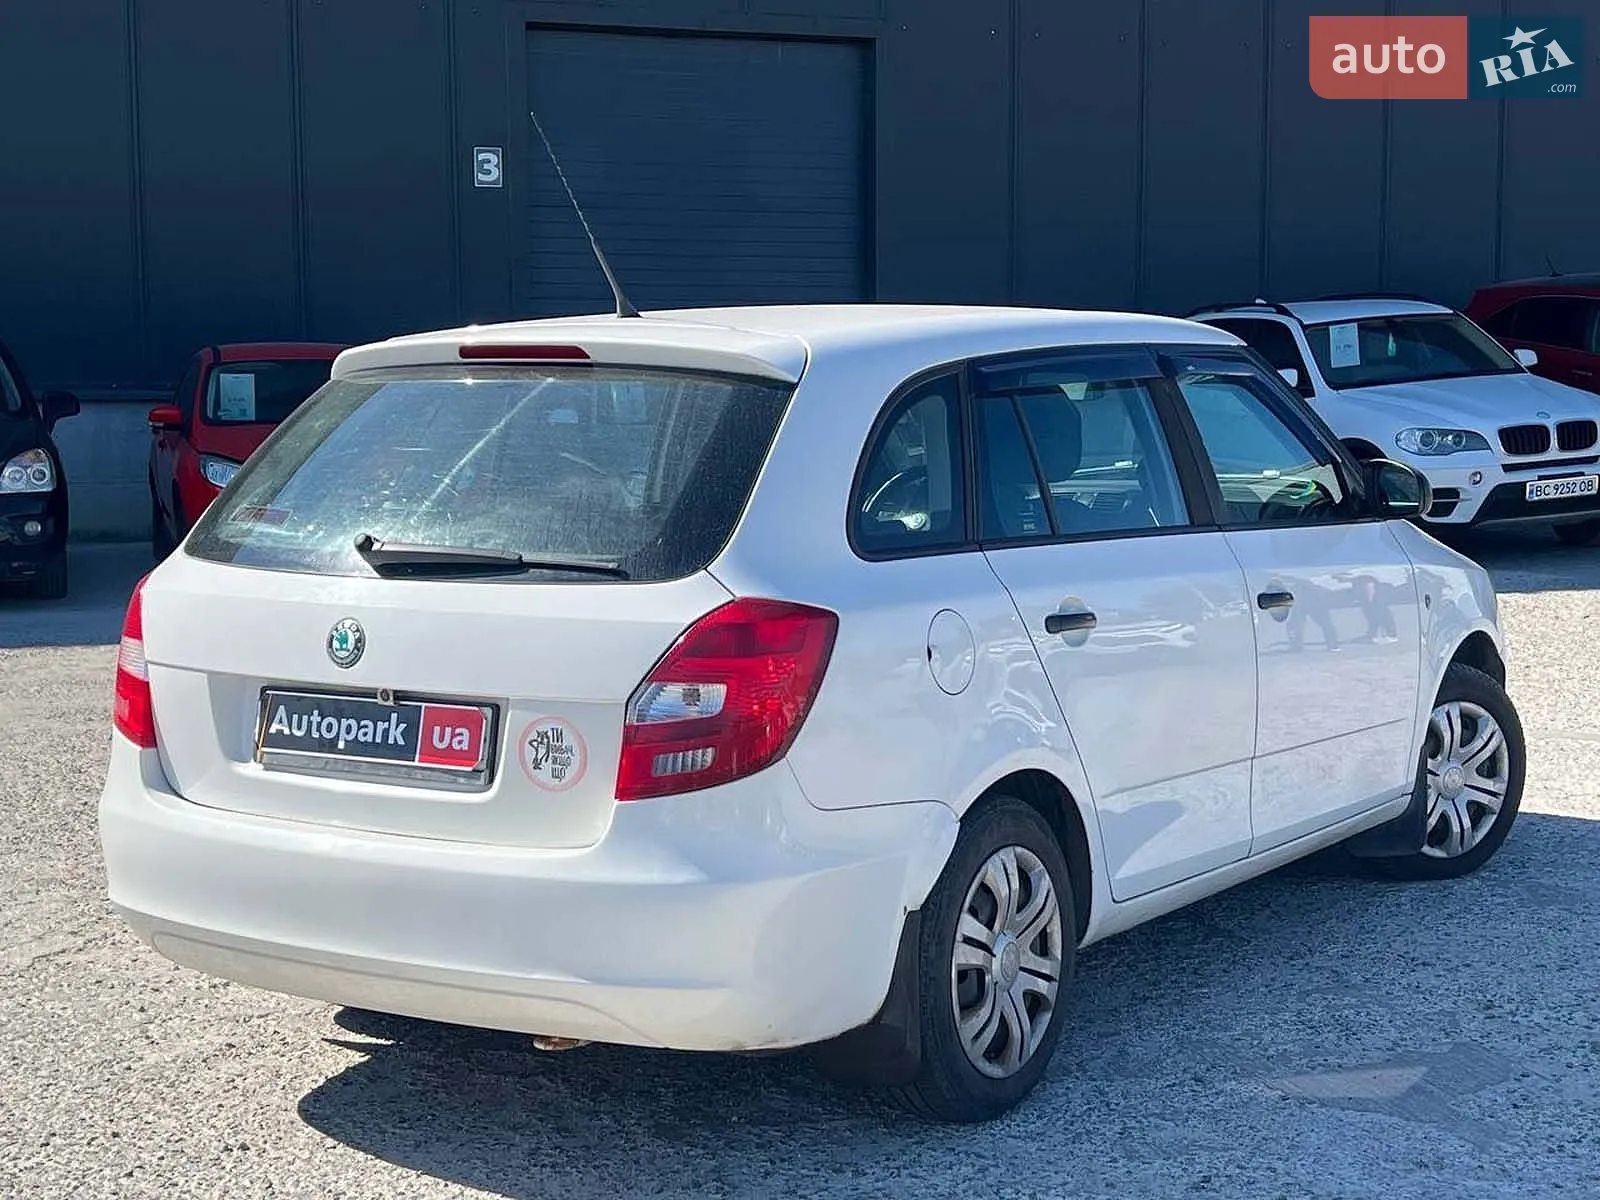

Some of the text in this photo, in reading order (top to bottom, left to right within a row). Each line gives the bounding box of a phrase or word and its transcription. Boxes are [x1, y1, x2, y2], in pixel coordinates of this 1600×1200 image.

[477, 152, 499, 182] 3
[1553, 482, 1577, 496] 9252
[268, 704, 470, 751] Autopark ua
